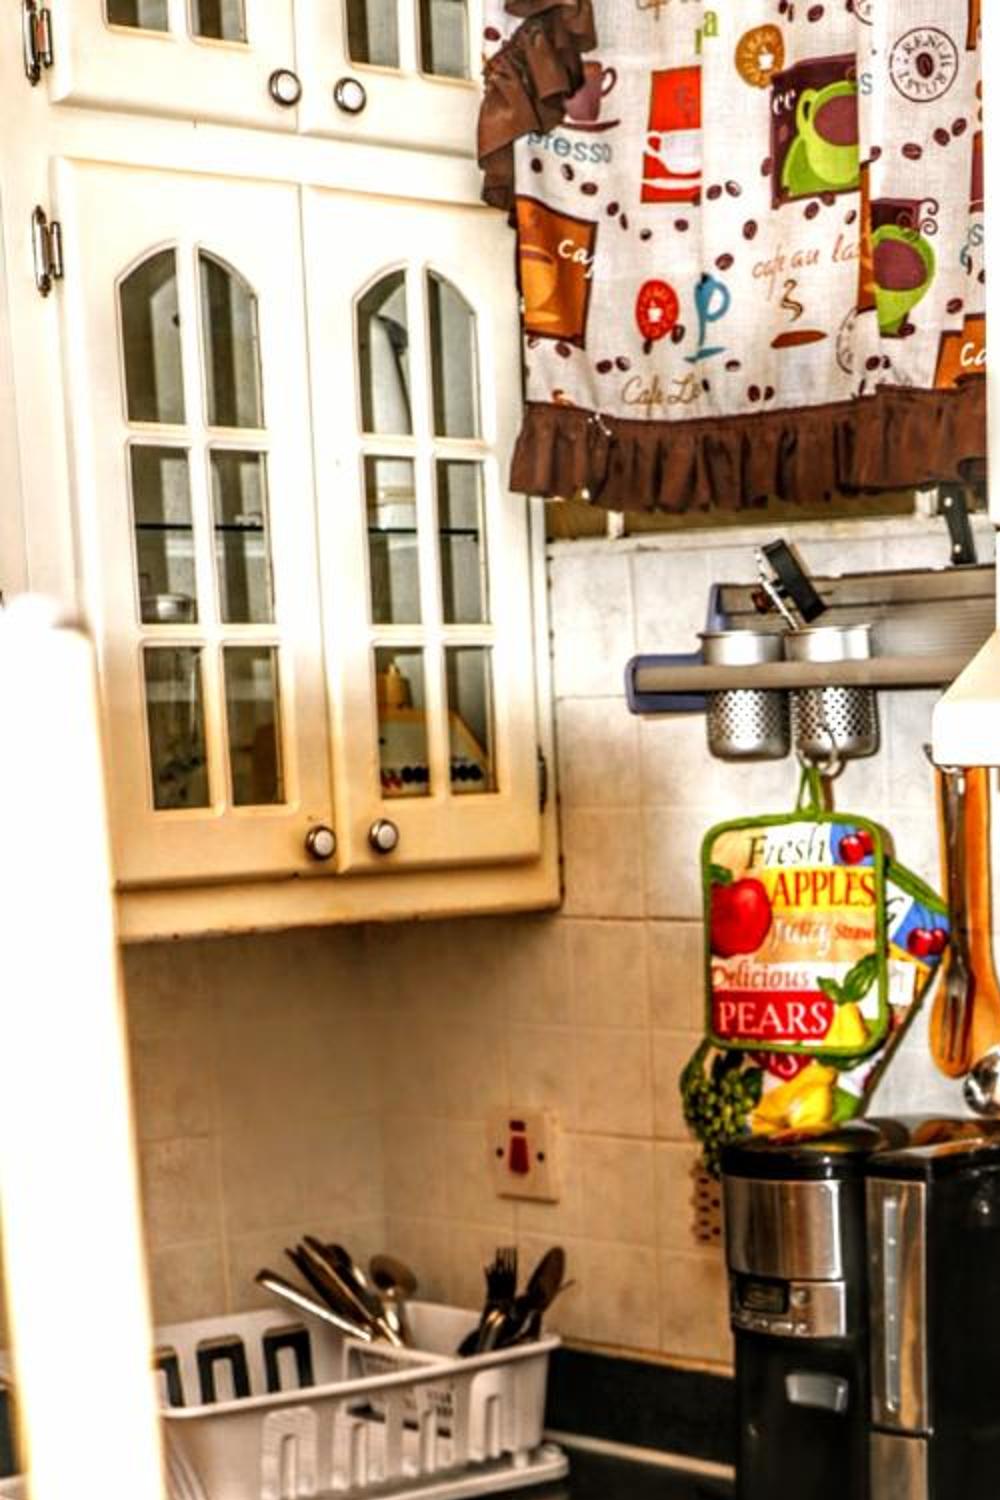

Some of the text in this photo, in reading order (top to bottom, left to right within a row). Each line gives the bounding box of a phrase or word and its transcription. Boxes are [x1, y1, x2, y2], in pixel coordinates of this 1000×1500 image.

[746, 826, 826, 871] Fresh
[772, 869, 877, 907] APPLES
[711, 958, 812, 989] Delicious
[718, 1000, 828, 1035] PEARS
